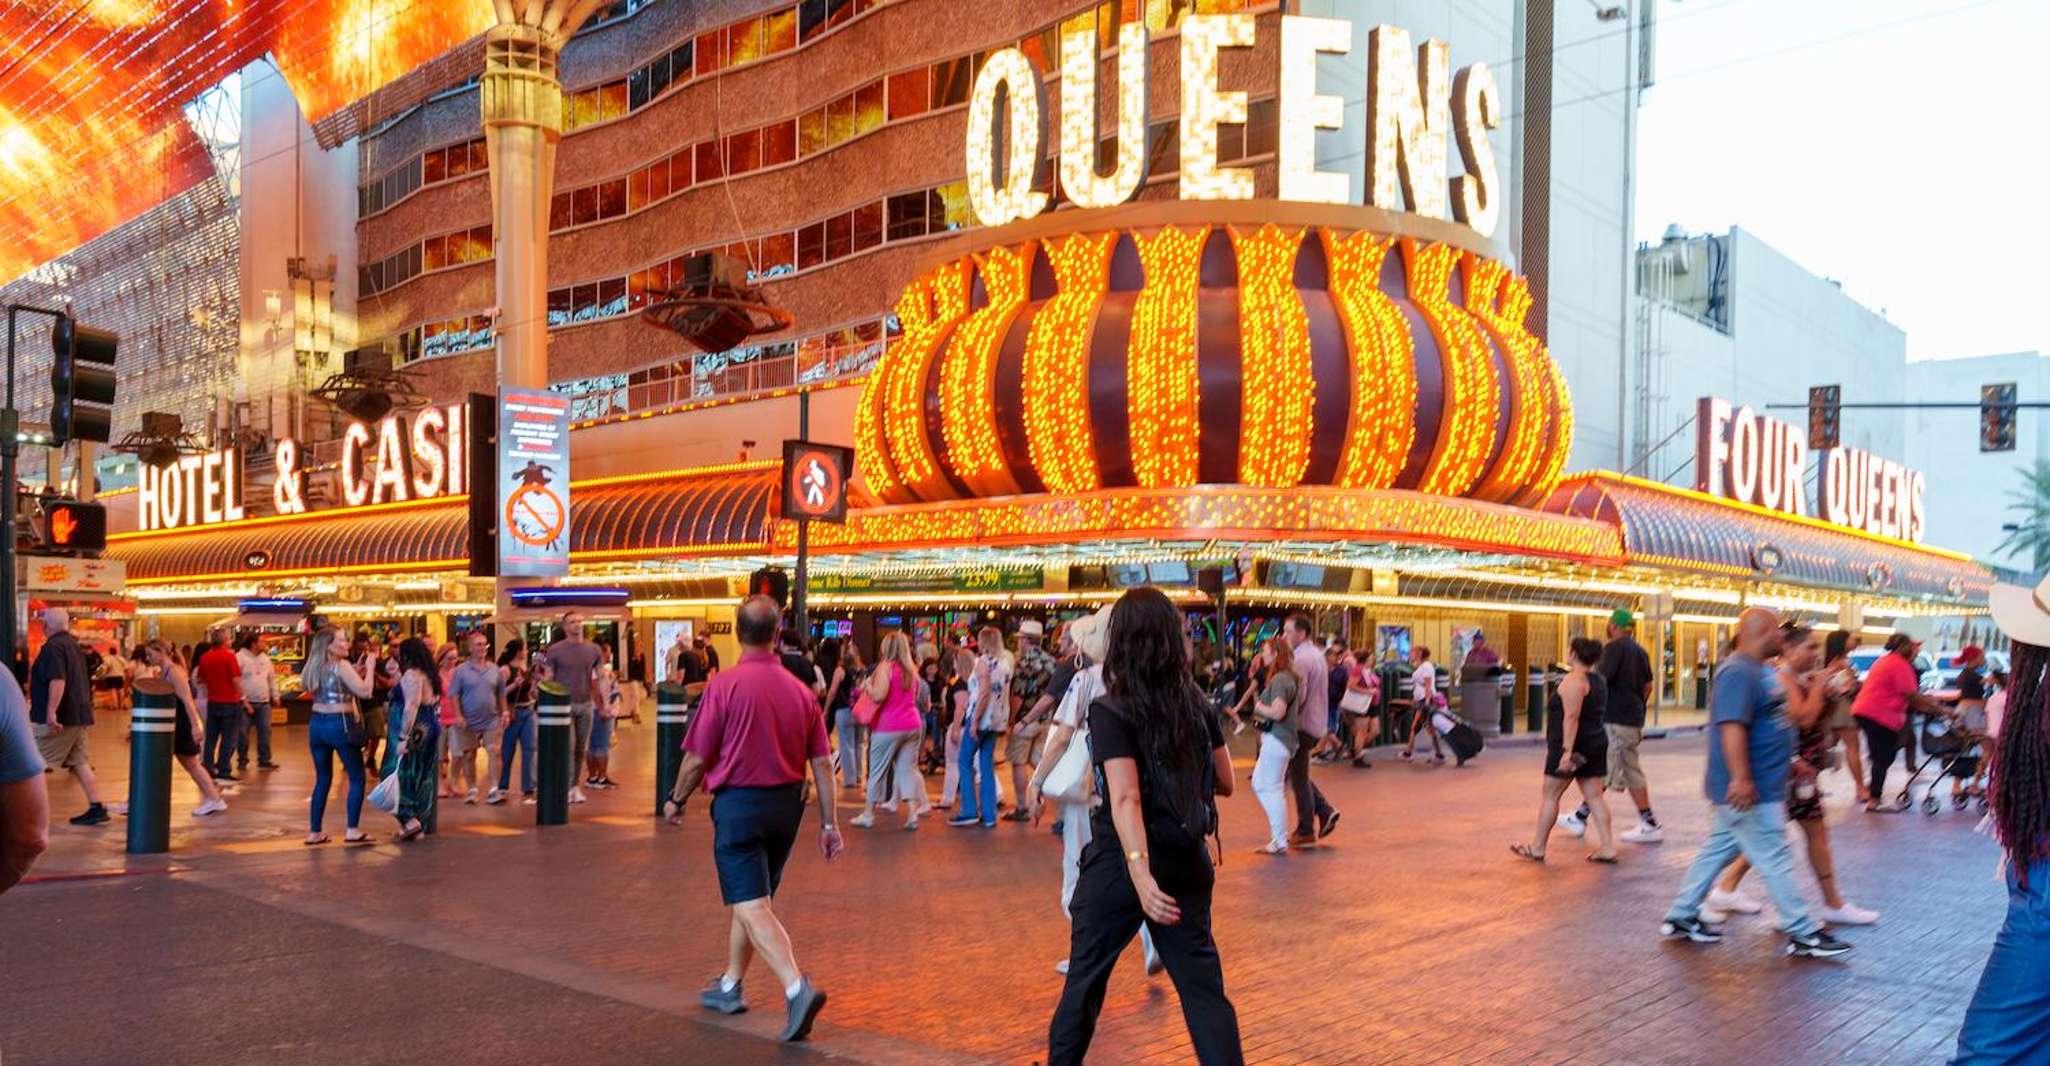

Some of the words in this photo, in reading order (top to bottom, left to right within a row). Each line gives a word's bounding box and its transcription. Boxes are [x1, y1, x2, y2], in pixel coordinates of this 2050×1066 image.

[966, 13, 1500, 237] QUEENS
[138, 446, 244, 531] HOTEL
[272, 436, 306, 515] &
[341, 403, 470, 506] CASI
[1707, 395, 1808, 517] FOUR
[1825, 444, 1926, 544] QUEENS
